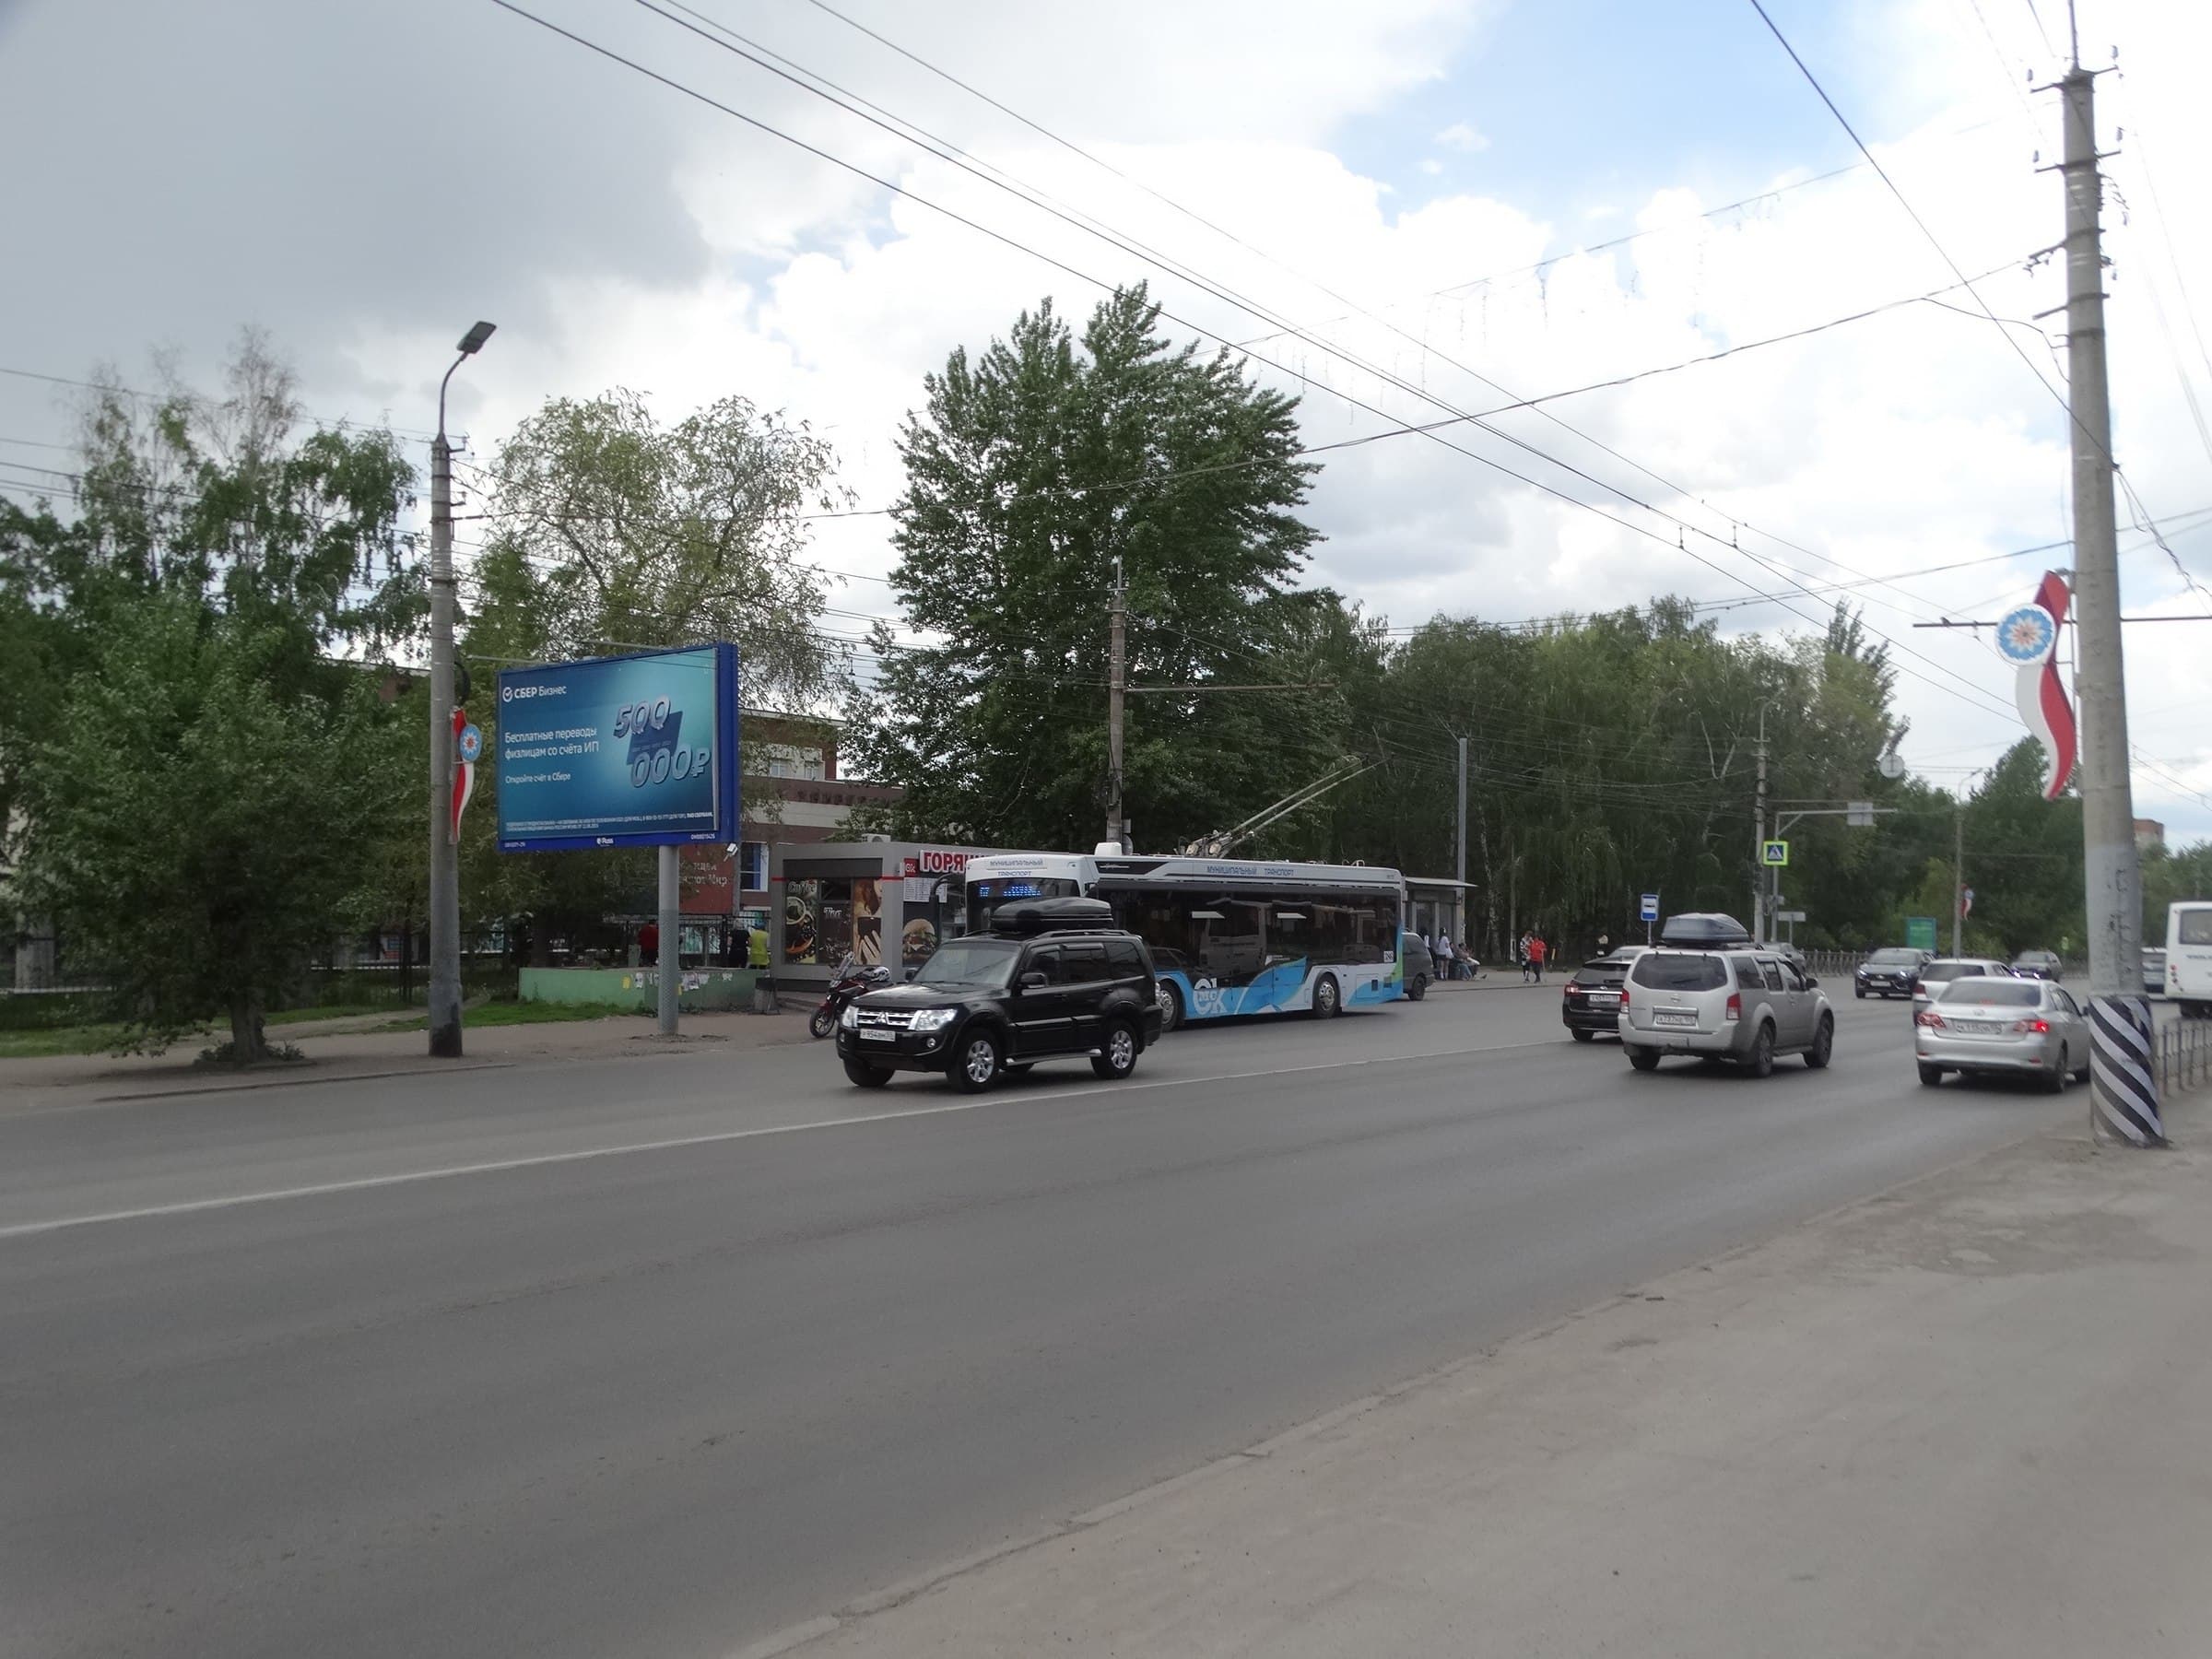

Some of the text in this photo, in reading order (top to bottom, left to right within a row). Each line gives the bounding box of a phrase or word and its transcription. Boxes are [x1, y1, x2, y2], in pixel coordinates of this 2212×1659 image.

[514, 686, 567, 699] СБЕР Бизнес
[613, 694, 671, 738] 500
[505, 728, 597, 743] Бесплатные переводы
[505, 741, 599, 760] физлицам со счёта ИП
